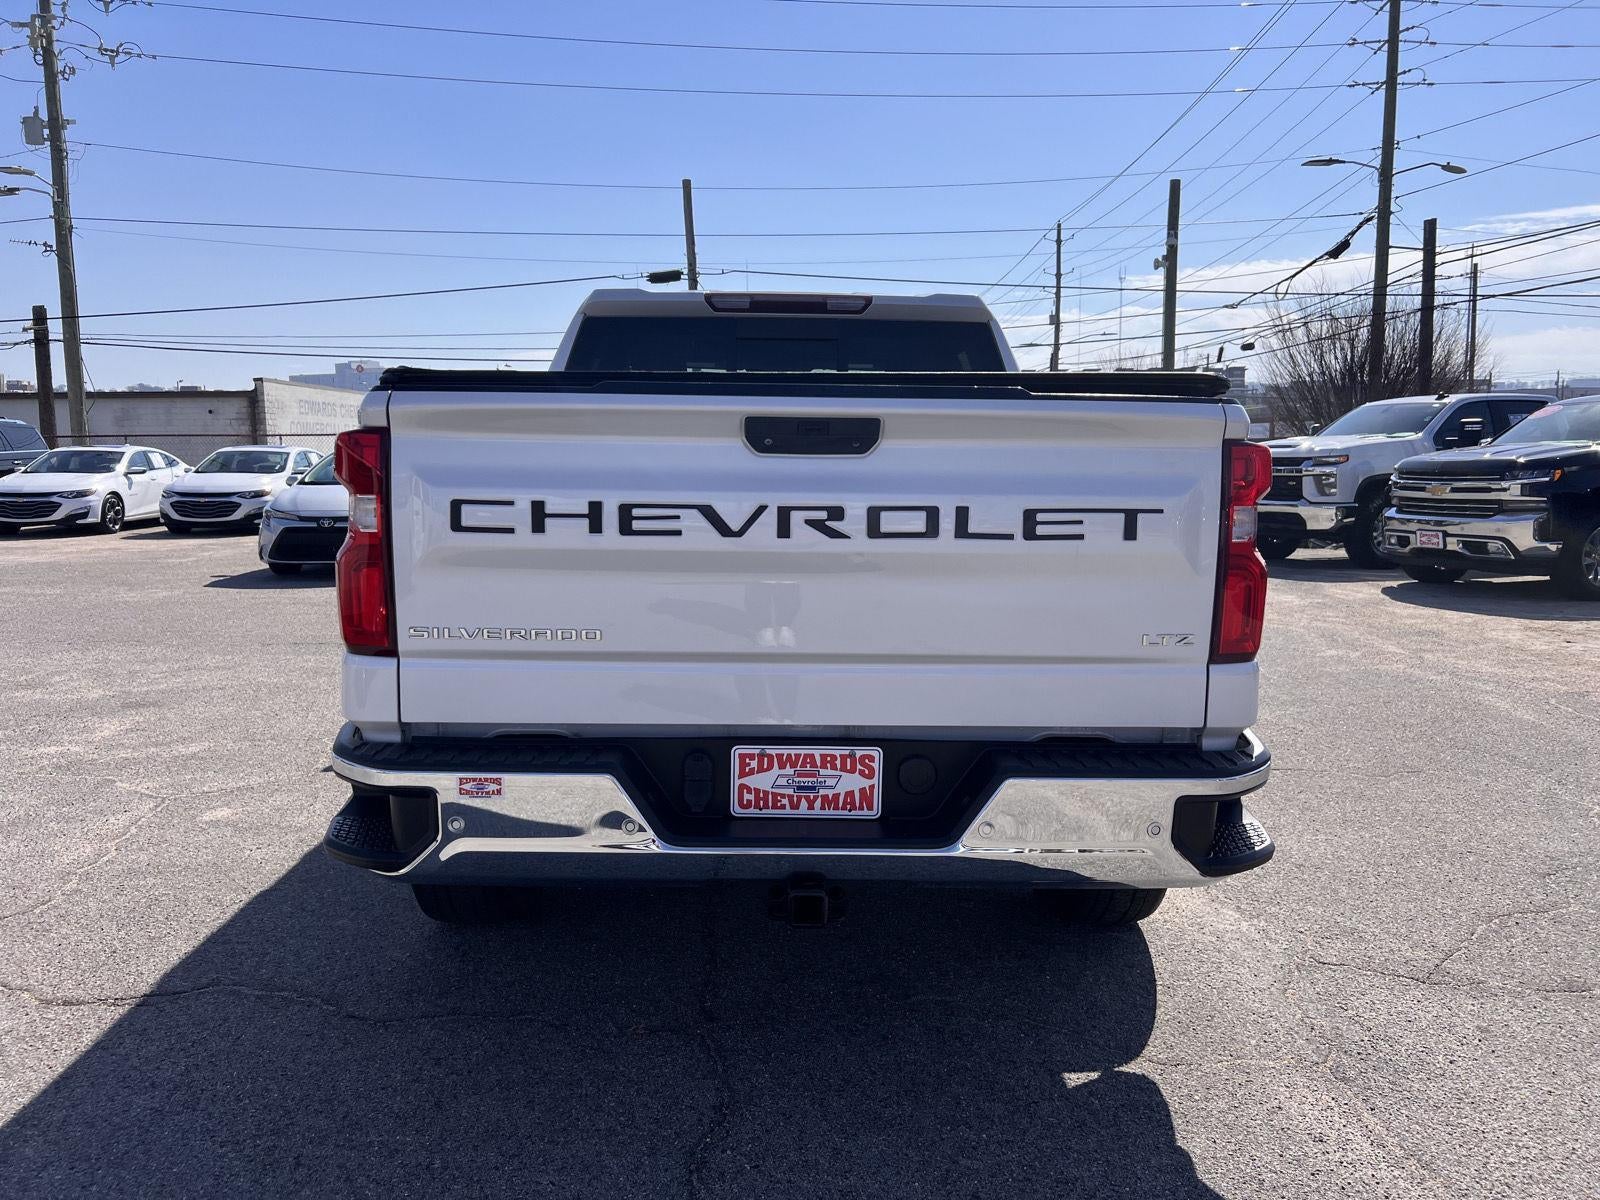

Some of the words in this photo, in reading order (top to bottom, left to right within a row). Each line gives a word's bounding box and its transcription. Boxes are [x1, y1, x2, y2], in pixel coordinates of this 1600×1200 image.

[298, 399, 337, 418] EDWARDS
[449, 498, 1165, 541] CHEVROLET
[408, 626, 603, 641] SILVERADO
[1141, 633, 1195, 646] LTZ
[737, 752, 876, 780] EDWARDS
[458, 777, 502, 786] EDWARDS
[786, 778, 827, 786] Chevrolet
[458, 787, 502, 796] CHEVYMAN
[737, 782, 876, 812] CHEVYMAN
